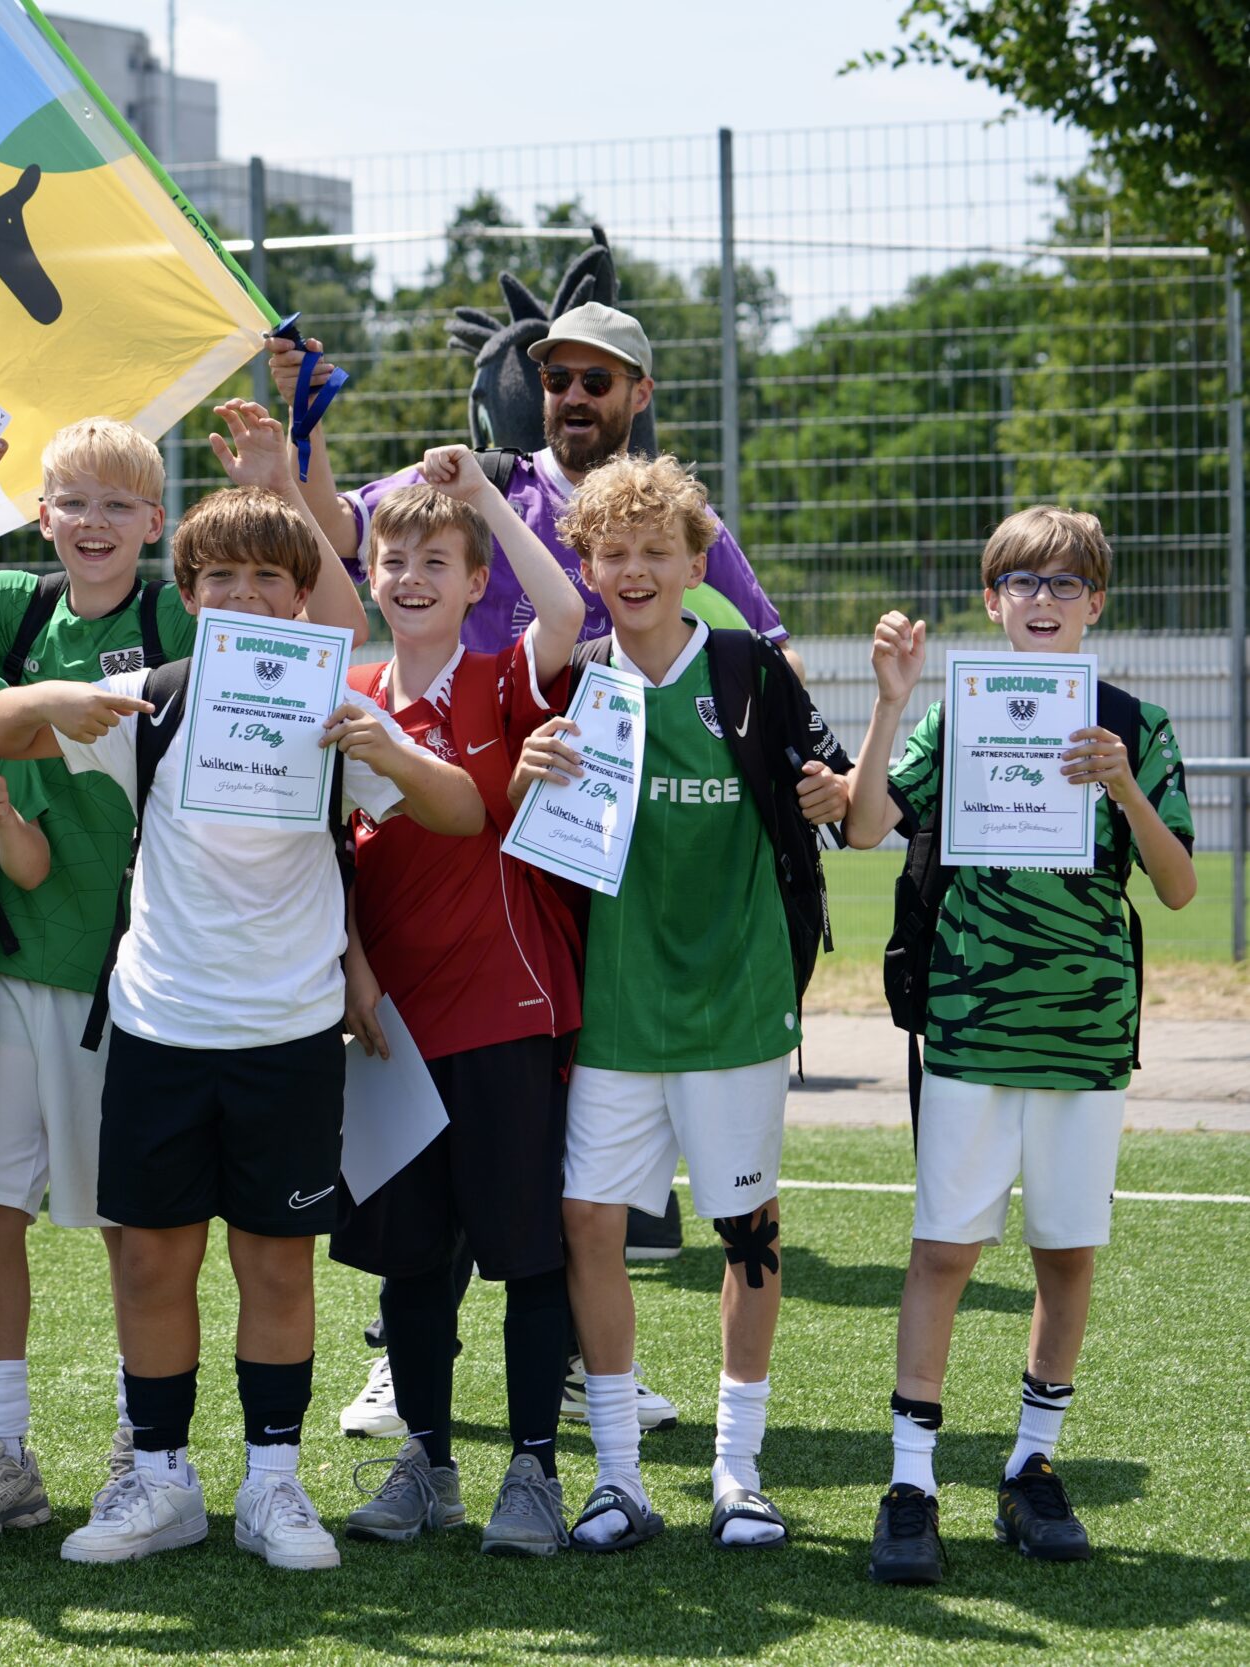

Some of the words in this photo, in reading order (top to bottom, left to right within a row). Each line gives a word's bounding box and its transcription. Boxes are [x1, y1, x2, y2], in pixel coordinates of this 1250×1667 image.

[512, 592, 532, 638] HITTO
[236, 636, 310, 661] URKUNDE
[986, 676, 1058, 694] URKUNDE
[221, 691, 230, 699] SC
[272, 696, 306, 709] MÜNSTER
[213, 705, 296, 721] PARTNERSCHULTURNIER
[299, 715, 316, 723] 2026
[978, 736, 987, 744] SC
[1029, 735, 1062, 745] MÜNSTER
[583, 746, 591, 755] SC
[971, 750, 1054, 759] PARTNERSCHULTURNIER
[580, 759, 627, 782] RTNERSCHULTURNIER
[650, 777, 740, 803] FIEGE
[734, 1172, 762, 1187] JAKO
[725, 1502, 766, 1514] PUMA
